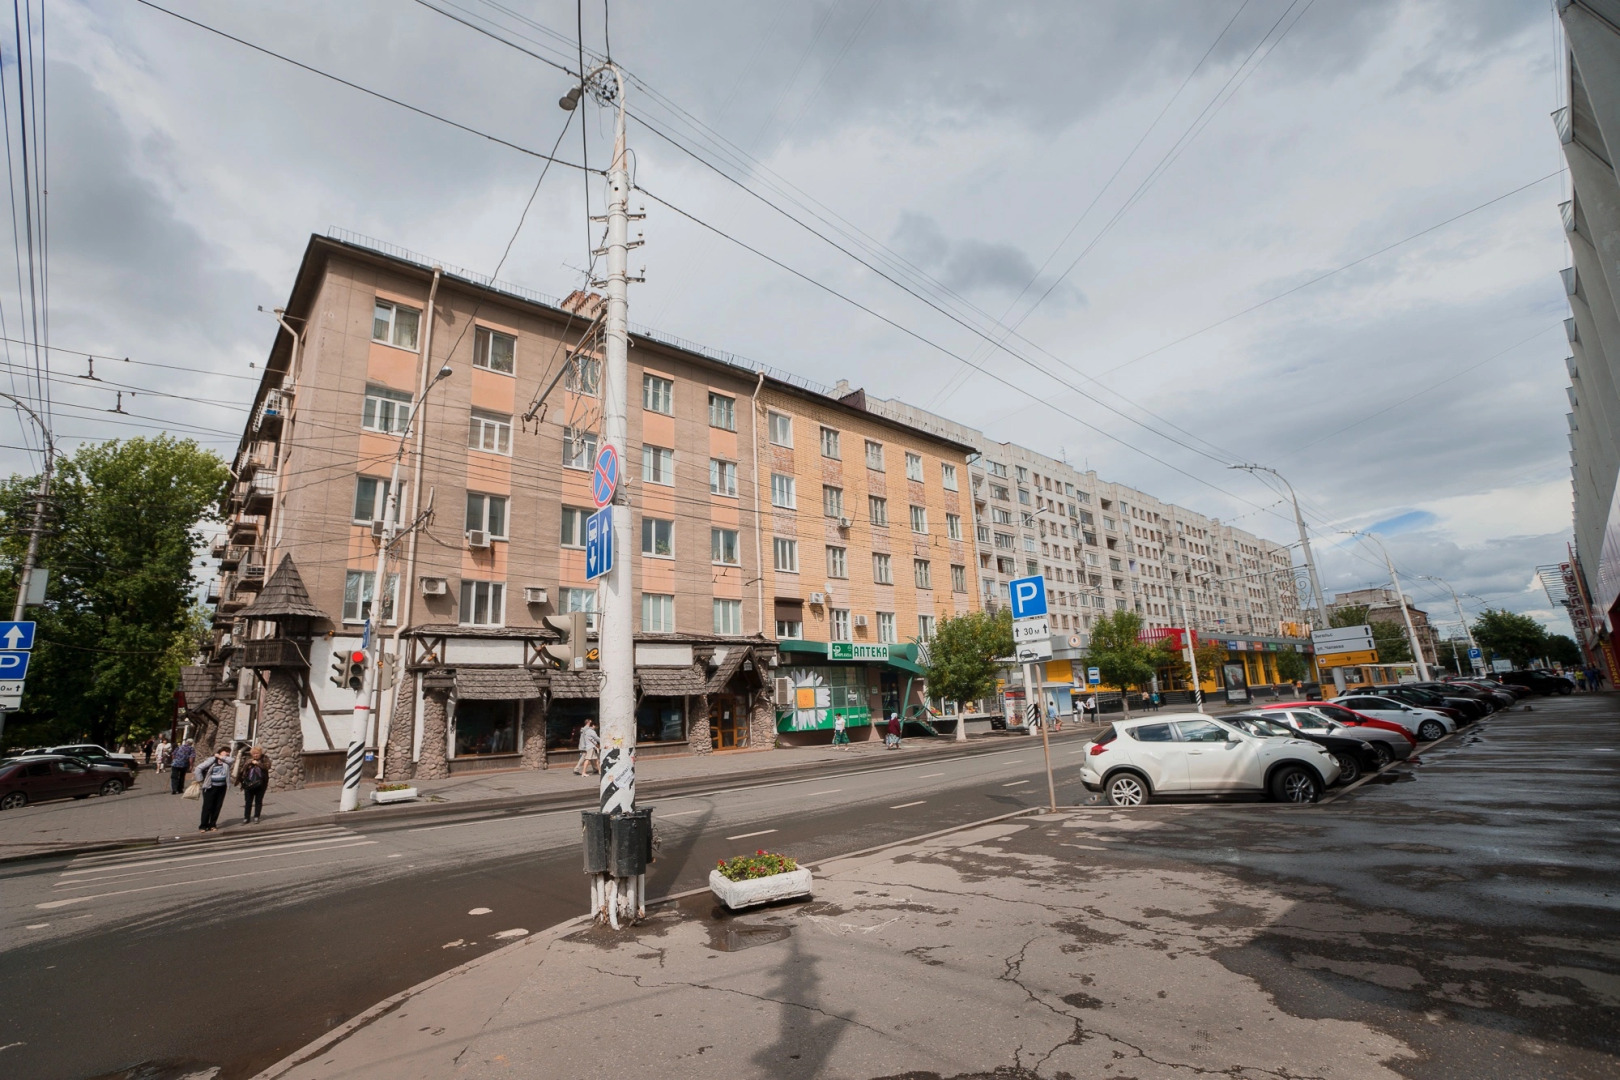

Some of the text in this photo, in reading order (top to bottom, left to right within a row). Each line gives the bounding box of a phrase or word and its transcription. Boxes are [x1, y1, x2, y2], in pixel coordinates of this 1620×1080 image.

[1016, 582, 1037, 613] P
[1024, 627, 1033, 636] 30
[853, 646, 888, 658] АПТЕКА
[1471, 650, 1478, 658] P
